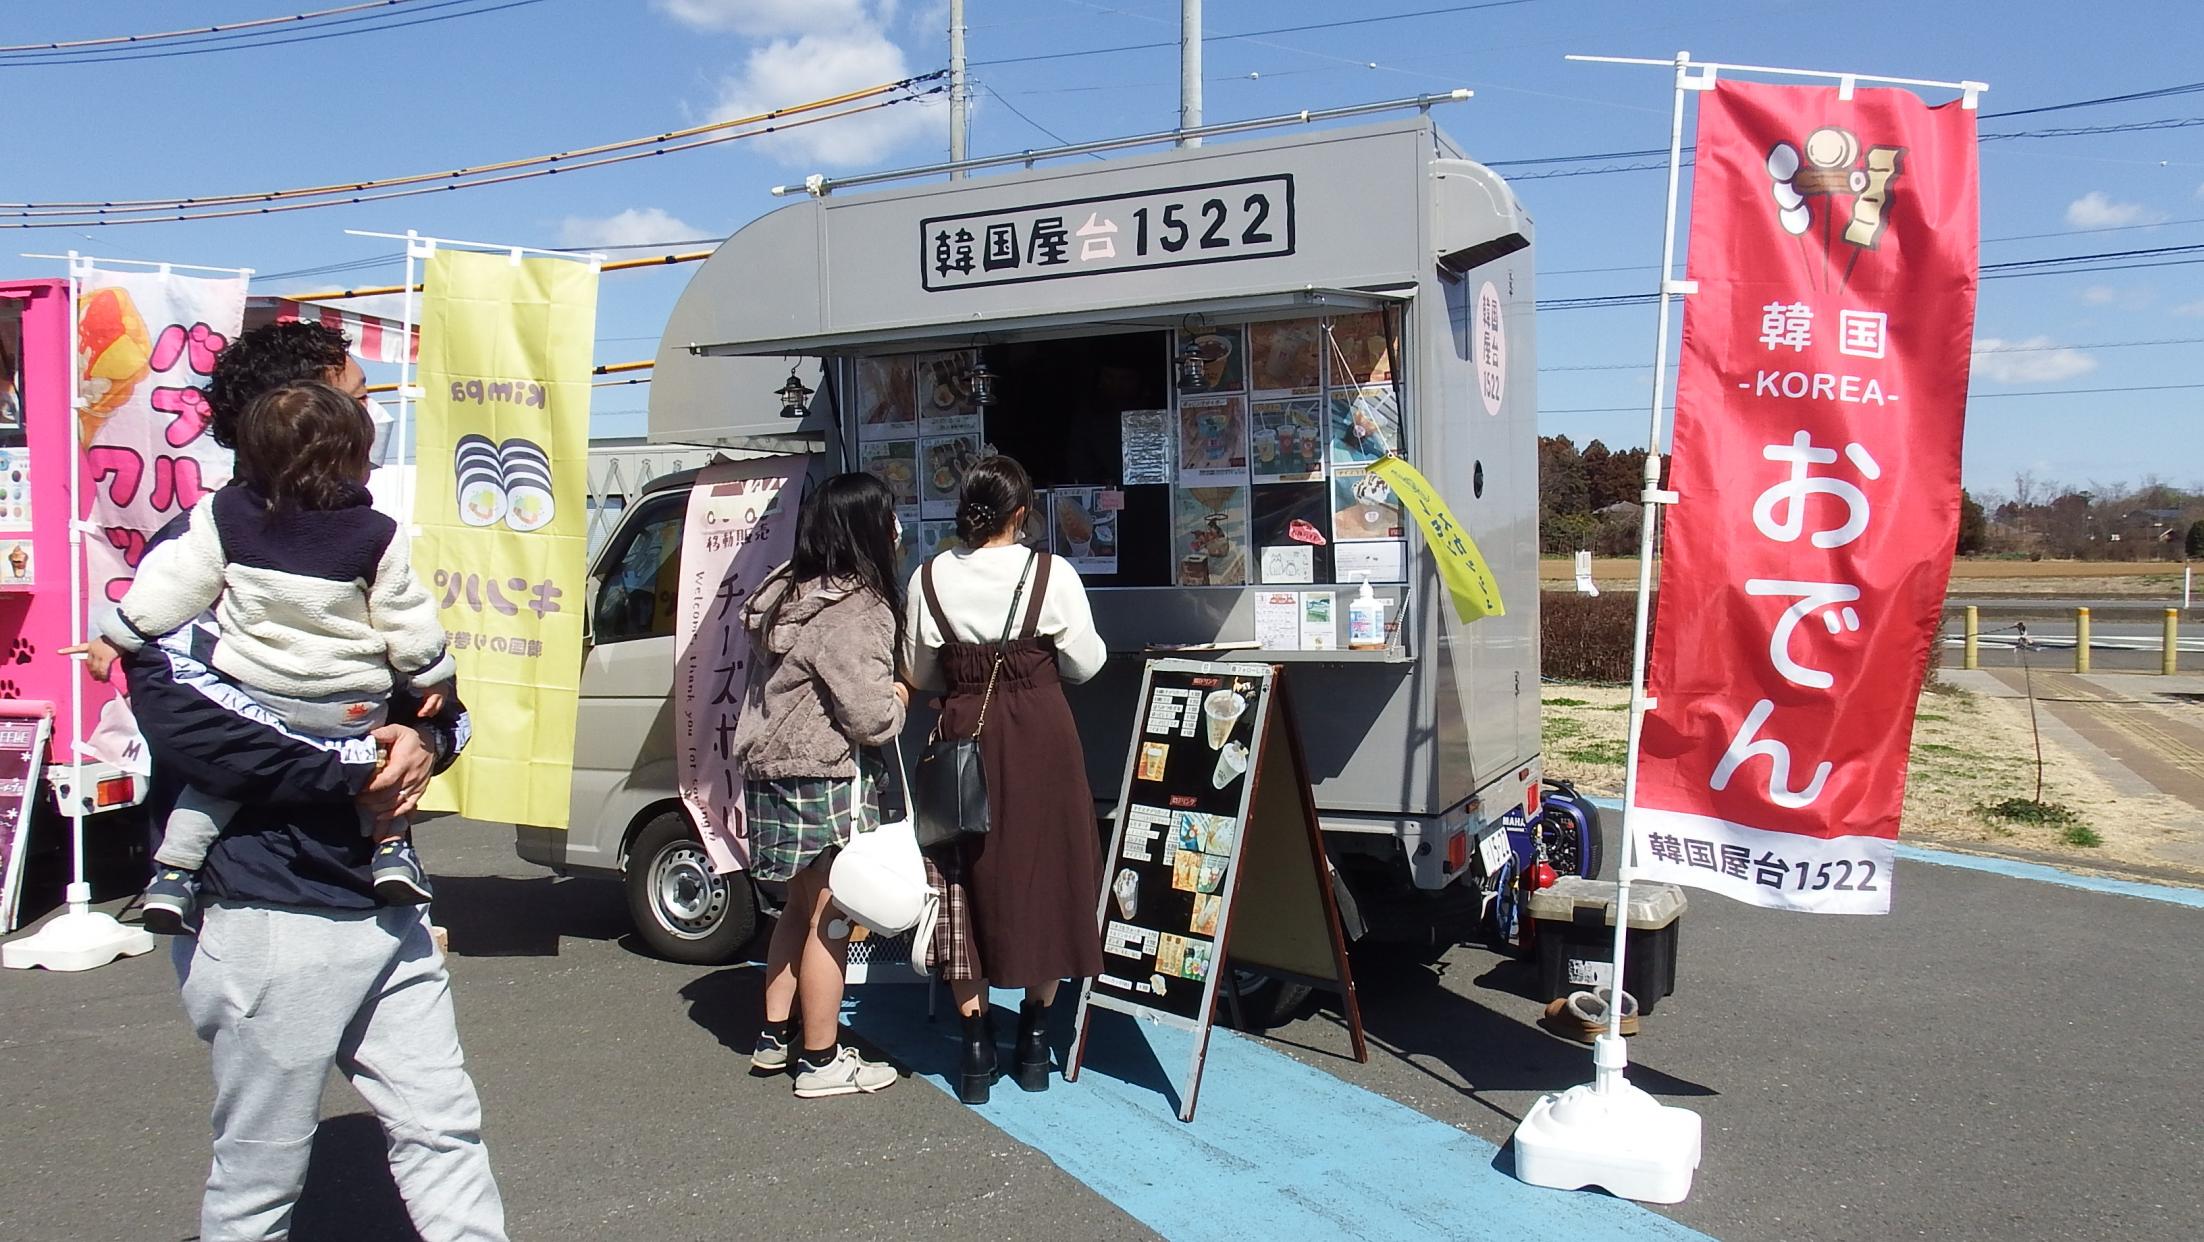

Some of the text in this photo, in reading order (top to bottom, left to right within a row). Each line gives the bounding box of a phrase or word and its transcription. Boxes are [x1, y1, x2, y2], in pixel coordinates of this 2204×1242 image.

[935, 193, 1273, 278] 韓国屋台1522
[1759, 301, 1888, 359] 韓国
[1483, 371, 1500, 401] 1522
[1738, 370, 1900, 407] -KOREA-
[706, 522, 770, 553] 移動販売
[1710, 429, 1881, 810] おでん
[1503, 816, 1526, 828] MAHA
[1648, 831, 1878, 893] 韓国屋台1522
